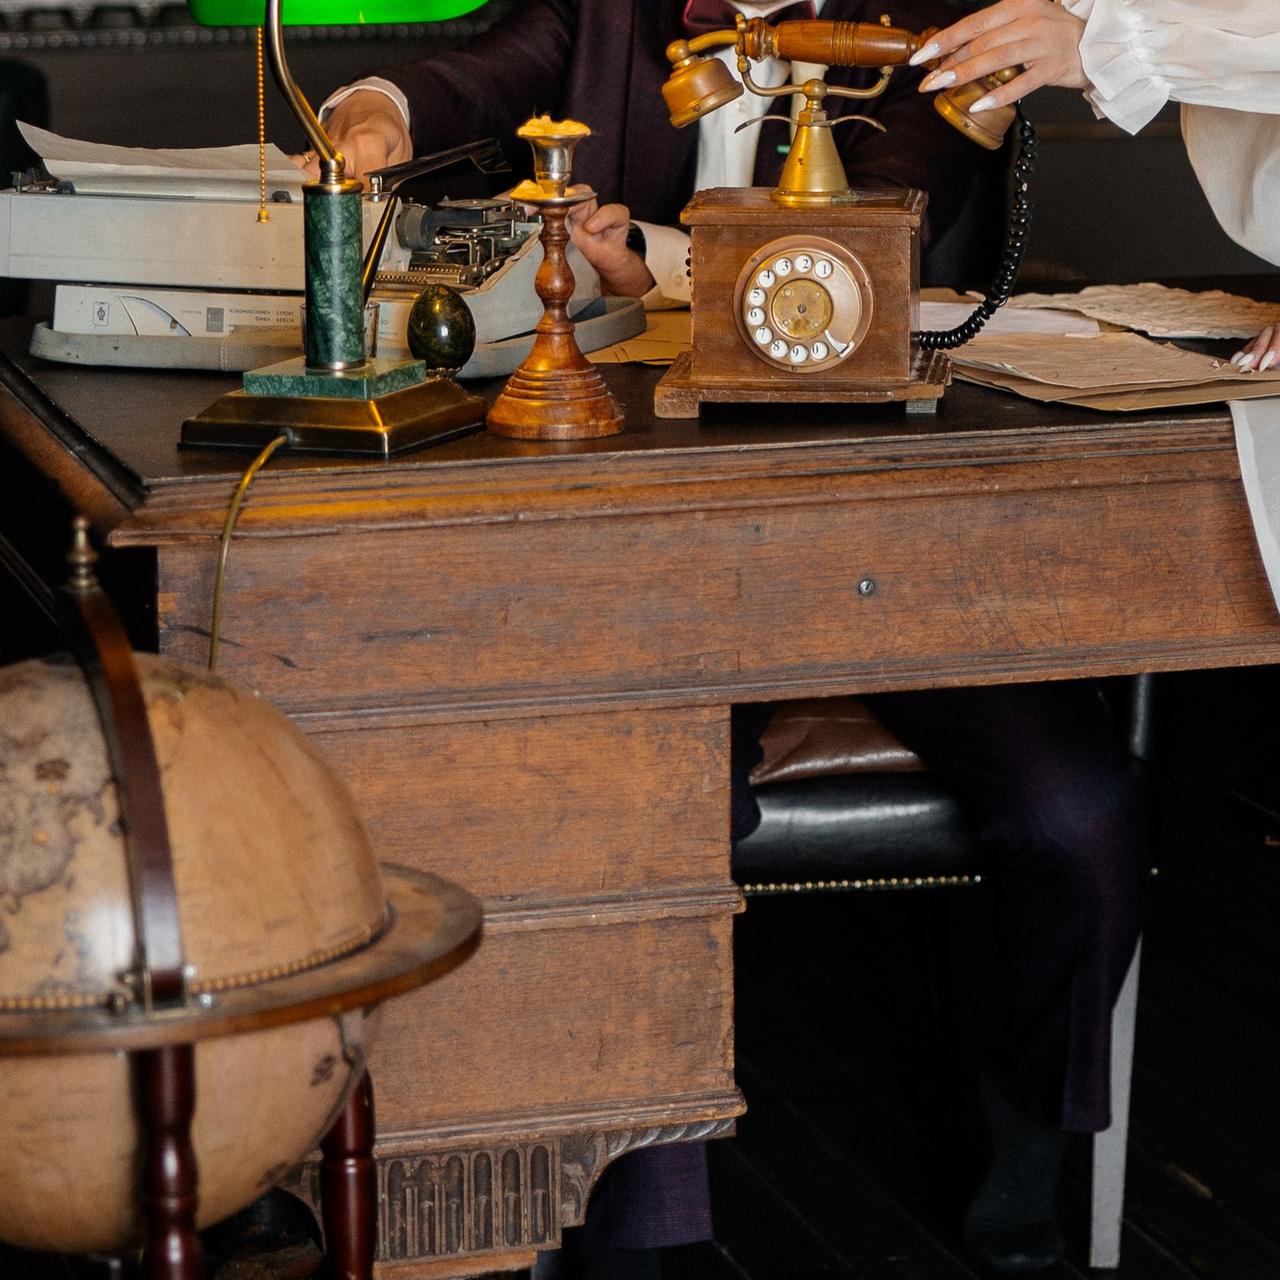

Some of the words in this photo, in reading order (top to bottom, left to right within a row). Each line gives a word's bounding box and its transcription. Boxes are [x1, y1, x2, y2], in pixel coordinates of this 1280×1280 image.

[782, 260, 789, 271] 3
[802, 258, 809, 269] 2
[763, 269, 770, 279] 4
[750, 308, 757, 318] 6
[759, 327, 766, 338] 7
[773, 341, 780, 351] 8
[812, 344, 819, 354] 0
[792, 347, 799, 357] 9
